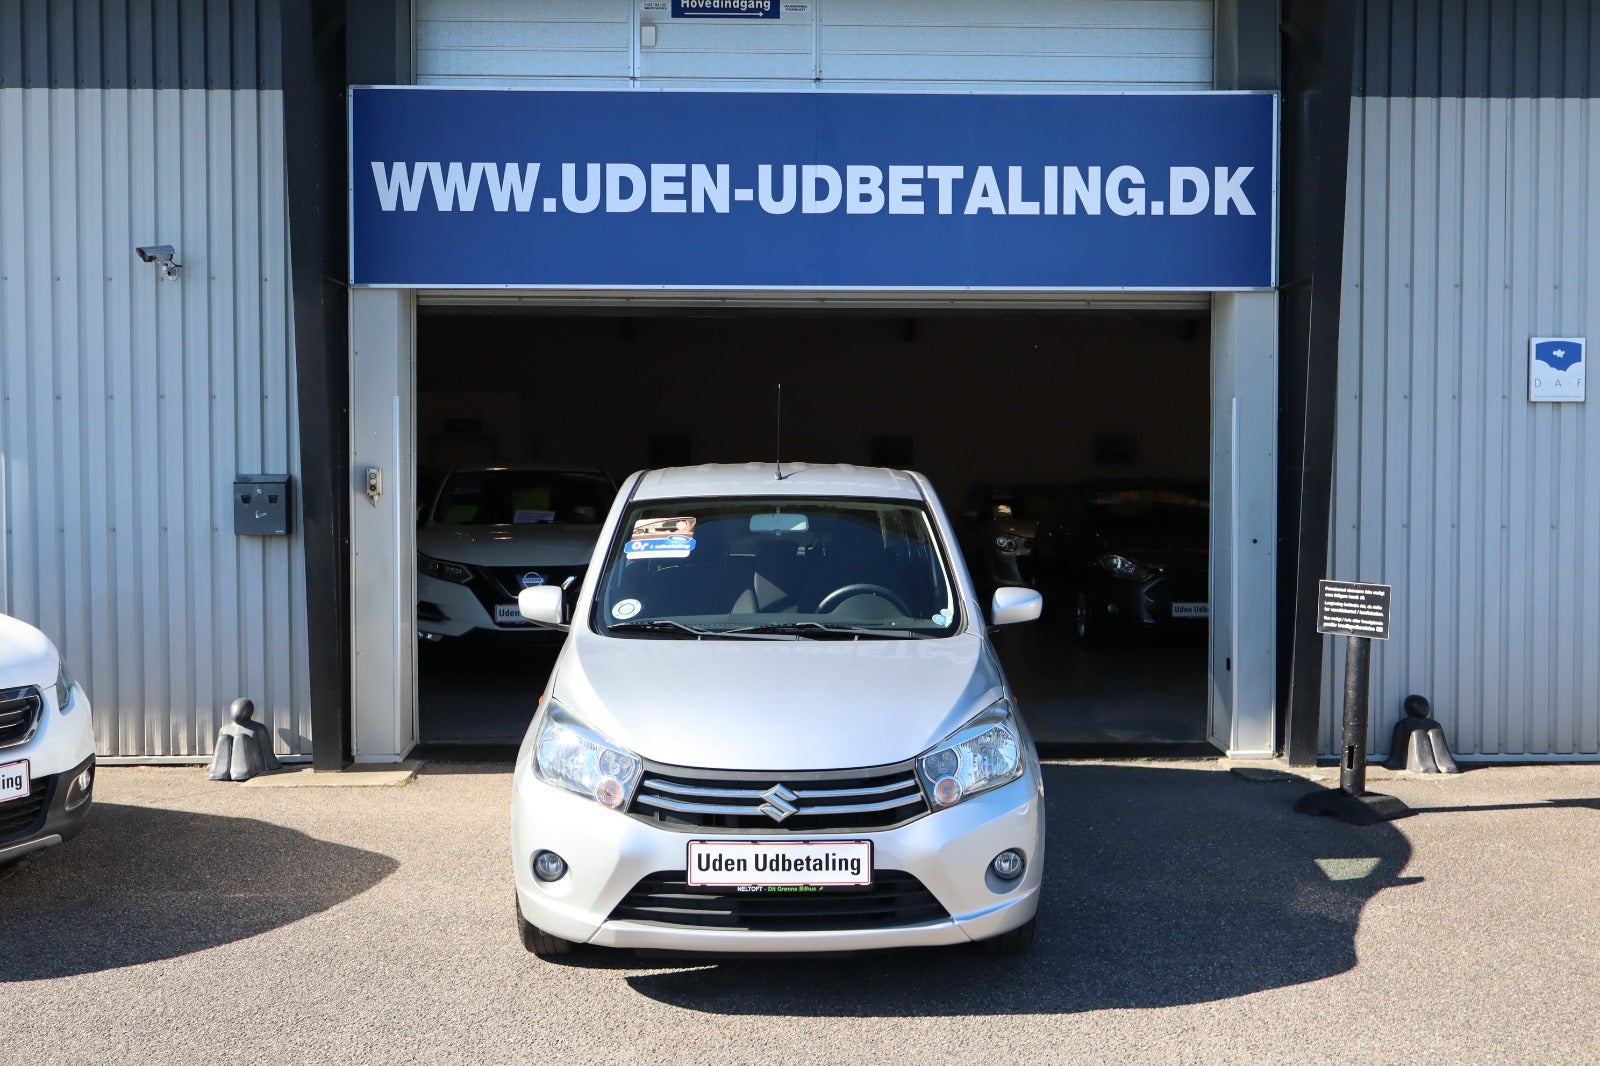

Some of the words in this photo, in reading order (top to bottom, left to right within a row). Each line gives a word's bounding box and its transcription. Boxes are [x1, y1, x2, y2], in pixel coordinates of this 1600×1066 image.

[681, 0, 771, 11] Hovedindgang
[371, 161, 1257, 217] WWW.UDEN-UDBETALING.DK
[697, 853, 747, 872] Uden
[754, 852, 861, 876] Udbetaling
